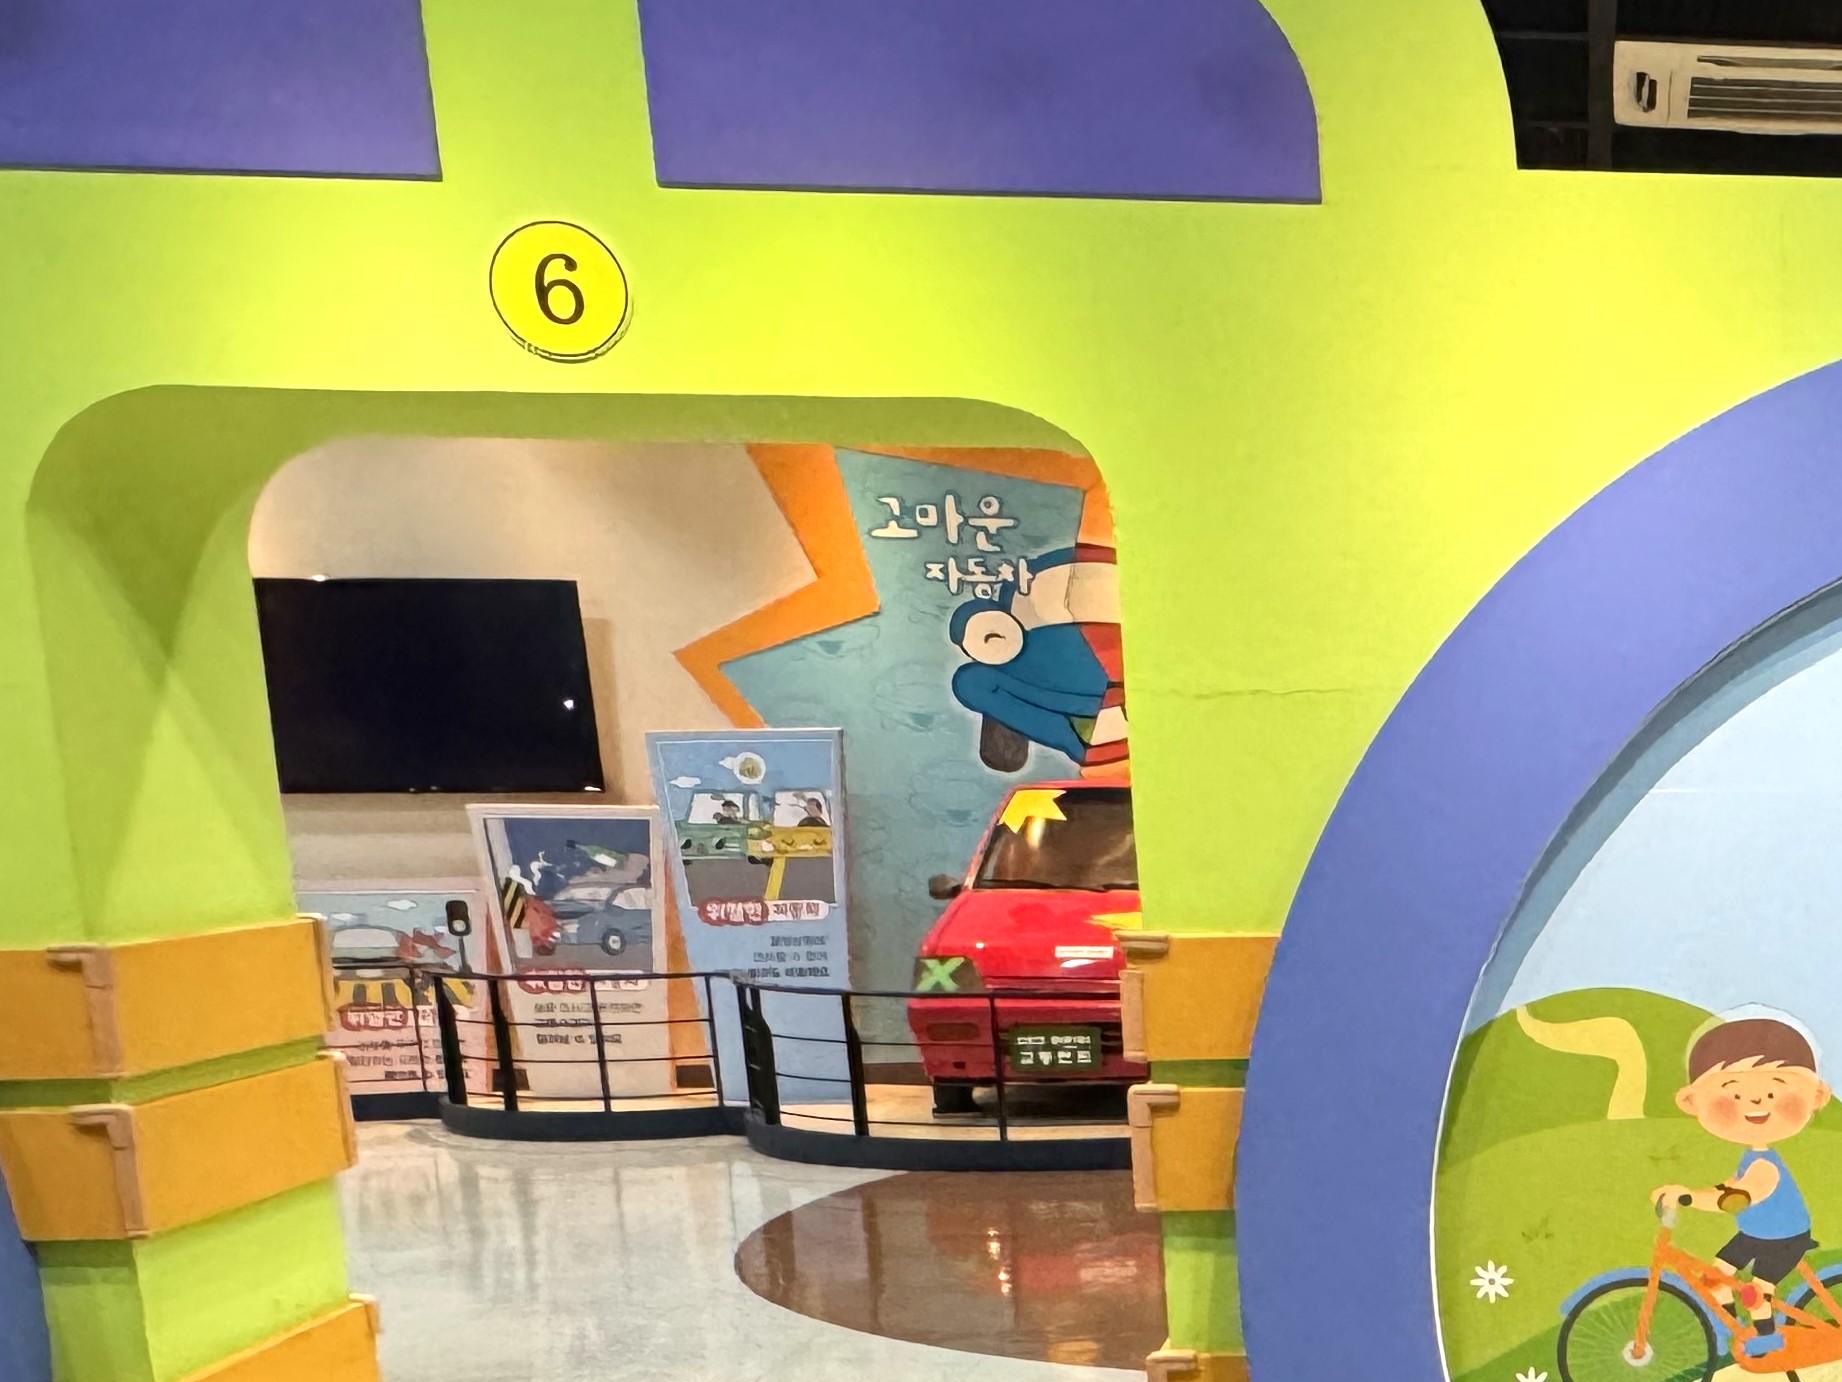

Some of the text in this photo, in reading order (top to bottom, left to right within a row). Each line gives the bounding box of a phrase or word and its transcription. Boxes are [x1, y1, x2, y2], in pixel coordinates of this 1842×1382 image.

[535, 253, 585, 325] 6
[869, 493, 1017, 553] 고마운
[924, 556, 1034, 600] 자동차
